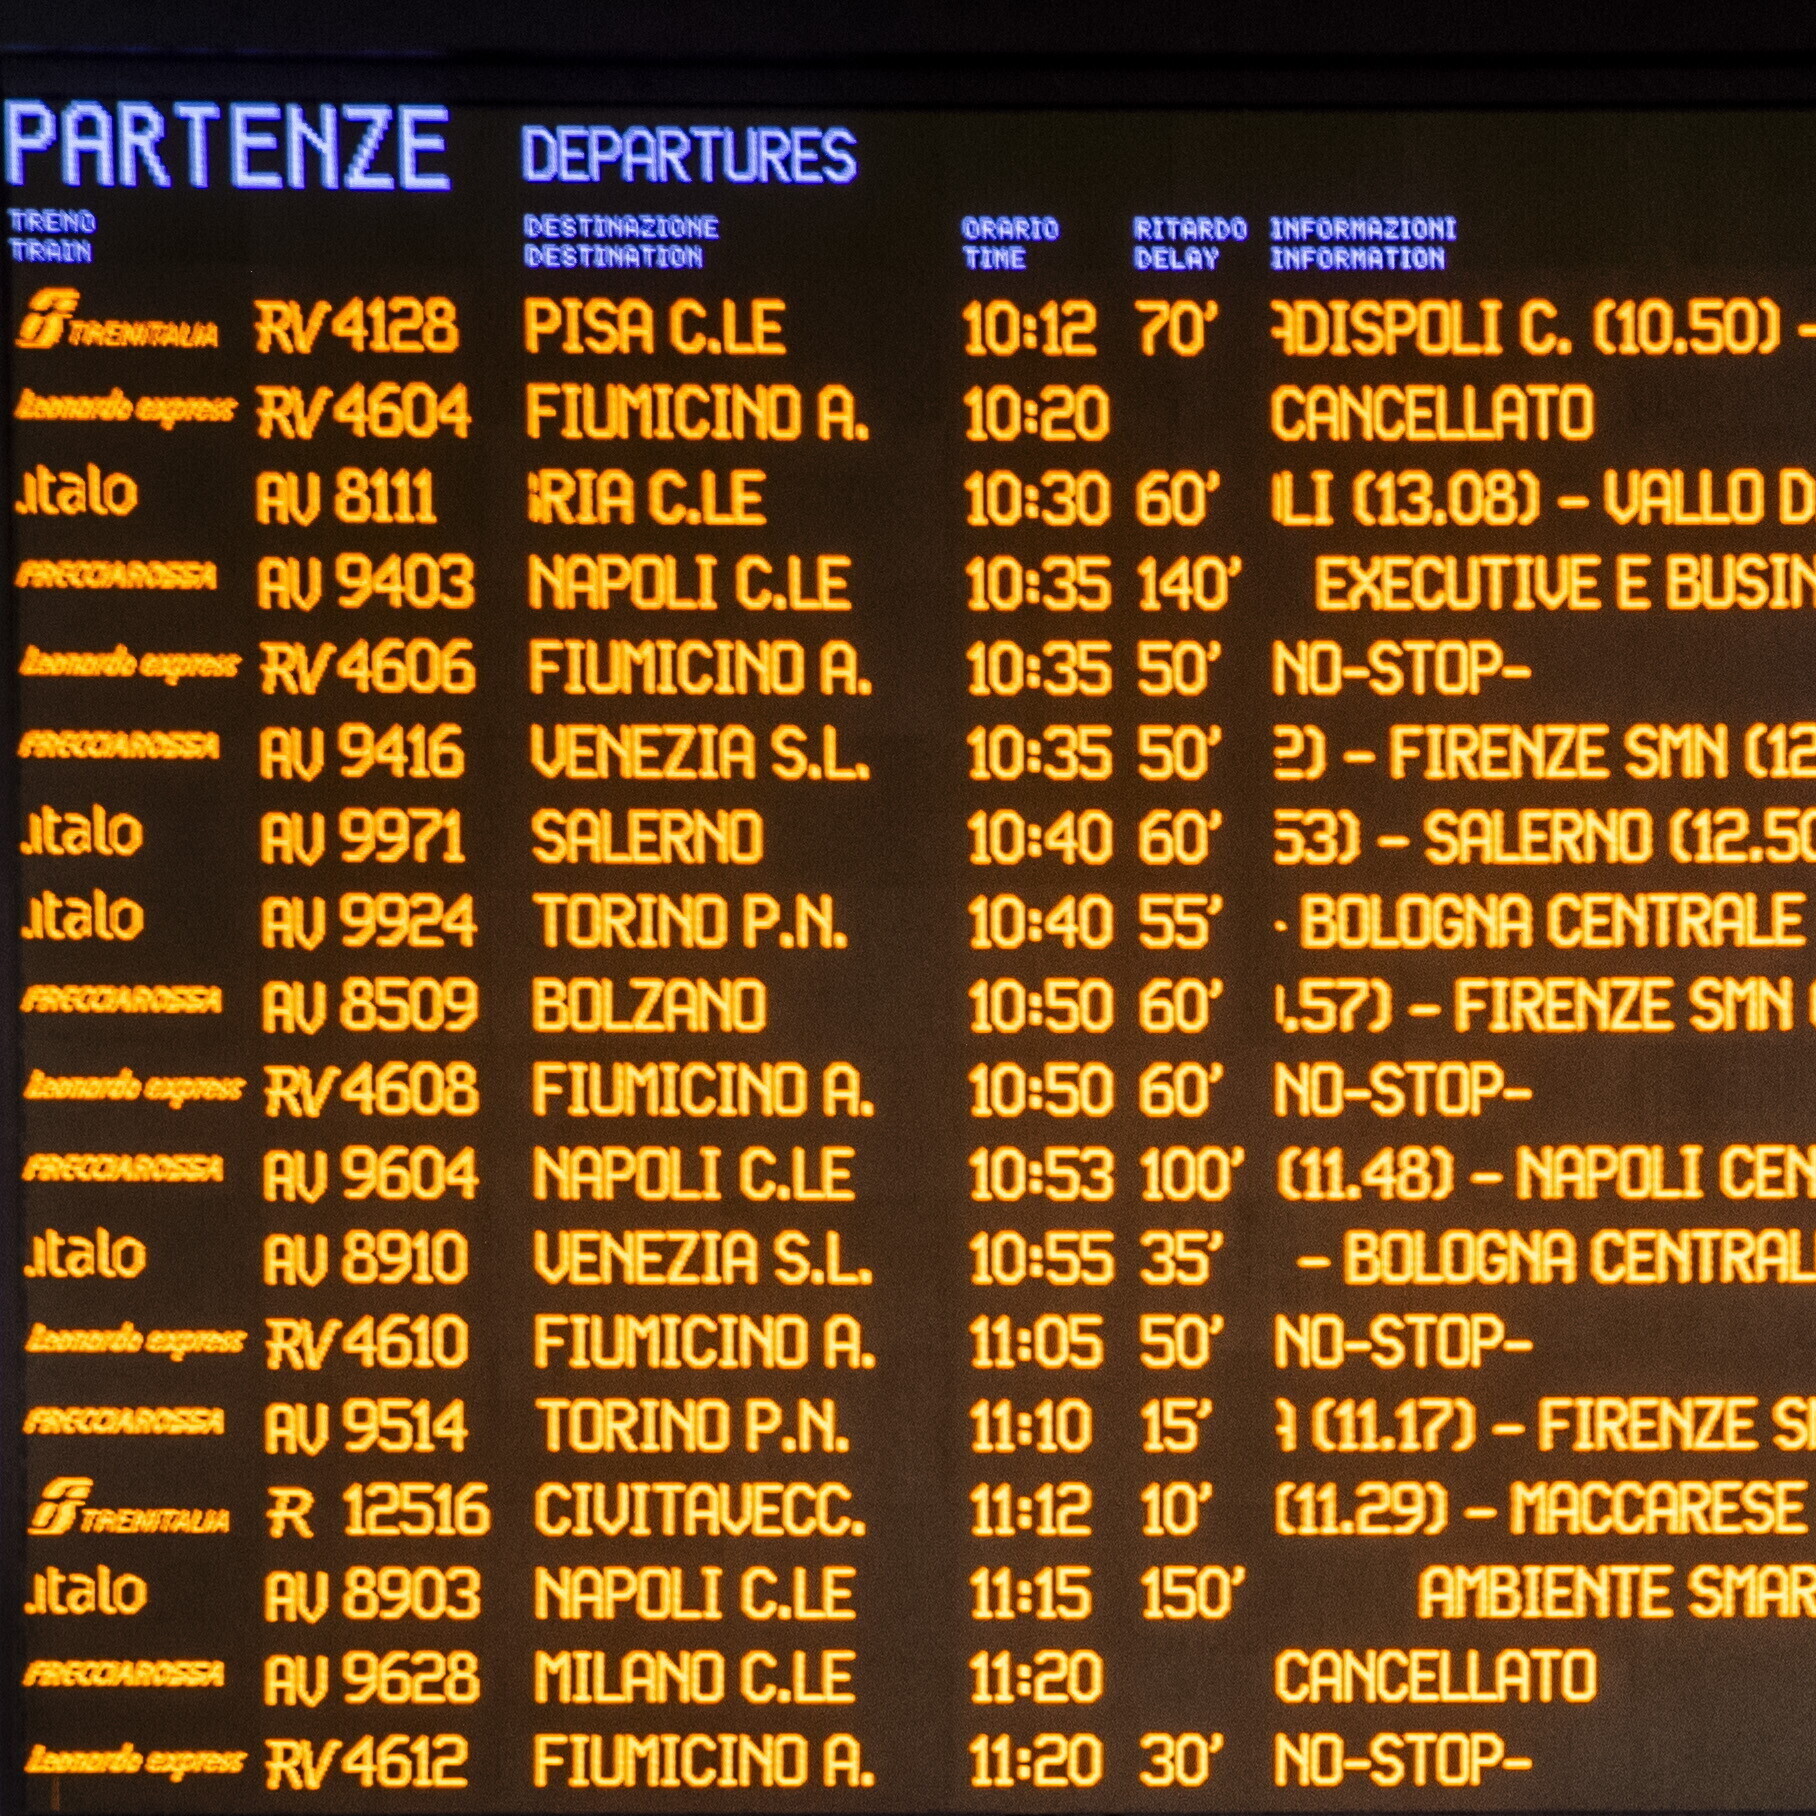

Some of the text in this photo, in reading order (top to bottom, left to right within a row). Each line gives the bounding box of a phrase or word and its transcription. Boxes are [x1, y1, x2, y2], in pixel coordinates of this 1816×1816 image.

[5, 100, 857, 191] PARTENZE DEPARTURES
[9, 209, 96, 234] TRENO
[524, 214, 719, 240] DESTINAZIONE
[962, 216, 1060, 240] ORARIO
[1133, 216, 1248, 241] RITARDO
[1270, 216, 1456, 241] INFORMAZIONI
[10, 238, 92, 263] TRAIN
[524, 244, 703, 269] DESTINATION
[963, 245, 1026, 270] TIME
[1134, 246, 1219, 271] DELAY
[1271, 246, 1445, 270] INFORMATION
[525, 297, 654, 354] PISA
[670, 298, 786, 355] C.LE
[963, 300, 1097, 356] 10:12
[1135, 300, 1218, 357] 70'
[1520, 298, 1572, 356] C.
[1593, 297, 1780, 355] (10.50)
[526, 383, 1594, 441] FIUMICINO A. 10:20 CANCELLATO
[256, 467, 1765, 526] AV 8111 C.LE 10:30 60' (13.08) VALLO
[258, 556, 322, 612] AV
[335, 552, 475, 609] 9403
[529, 554, 718, 610] NAPOLI
[735, 554, 852, 611] C.LE
[965, 555, 1112, 611] 10:35
[1137, 555, 1242, 611] 140'
[1315, 554, 1602, 611] EXECUTIVE
[1615, 553, 1652, 611] E
[260, 727, 324, 782] AV
[338, 722, 465, 778] 9416
[530, 723, 756, 780] VENEZIA
[771, 724, 870, 781] S.L.
[966, 724, 1113, 781] 10:35
[1137, 724, 1222, 781] 50'
[1389, 722, 1611, 781] FIRENZE
[1623, 723, 1729, 780] SMN
[261, 812, 325, 866] AV
[339, 807, 465, 863] 9971
[531, 808, 764, 865] SALERNO
[967, 809, 1113, 865] 10:40
[1423, 807, 1654, 866] SALERNO
[266, 1486, 315, 1538] R
[343, 1481, 491, 1537] 12516
[535, 1481, 866, 1537] CIVITAVECC.
[969, 1481, 1093, 1538] 11:12
[1275, 1480, 1448, 1537] (11.29)
[1509, 1478, 1809, 1535] MACCARESE
[264, 1571, 329, 1624] AV
[342, 1565, 481, 1620] 8903
[1140, 1565, 1246, 1620] 150'
[1417, 1564, 1675, 1619] AMBIENTE
[264, 1647, 1598, 1708] AV 9628 MILANO C.LE 11:20 CANCELLATO
